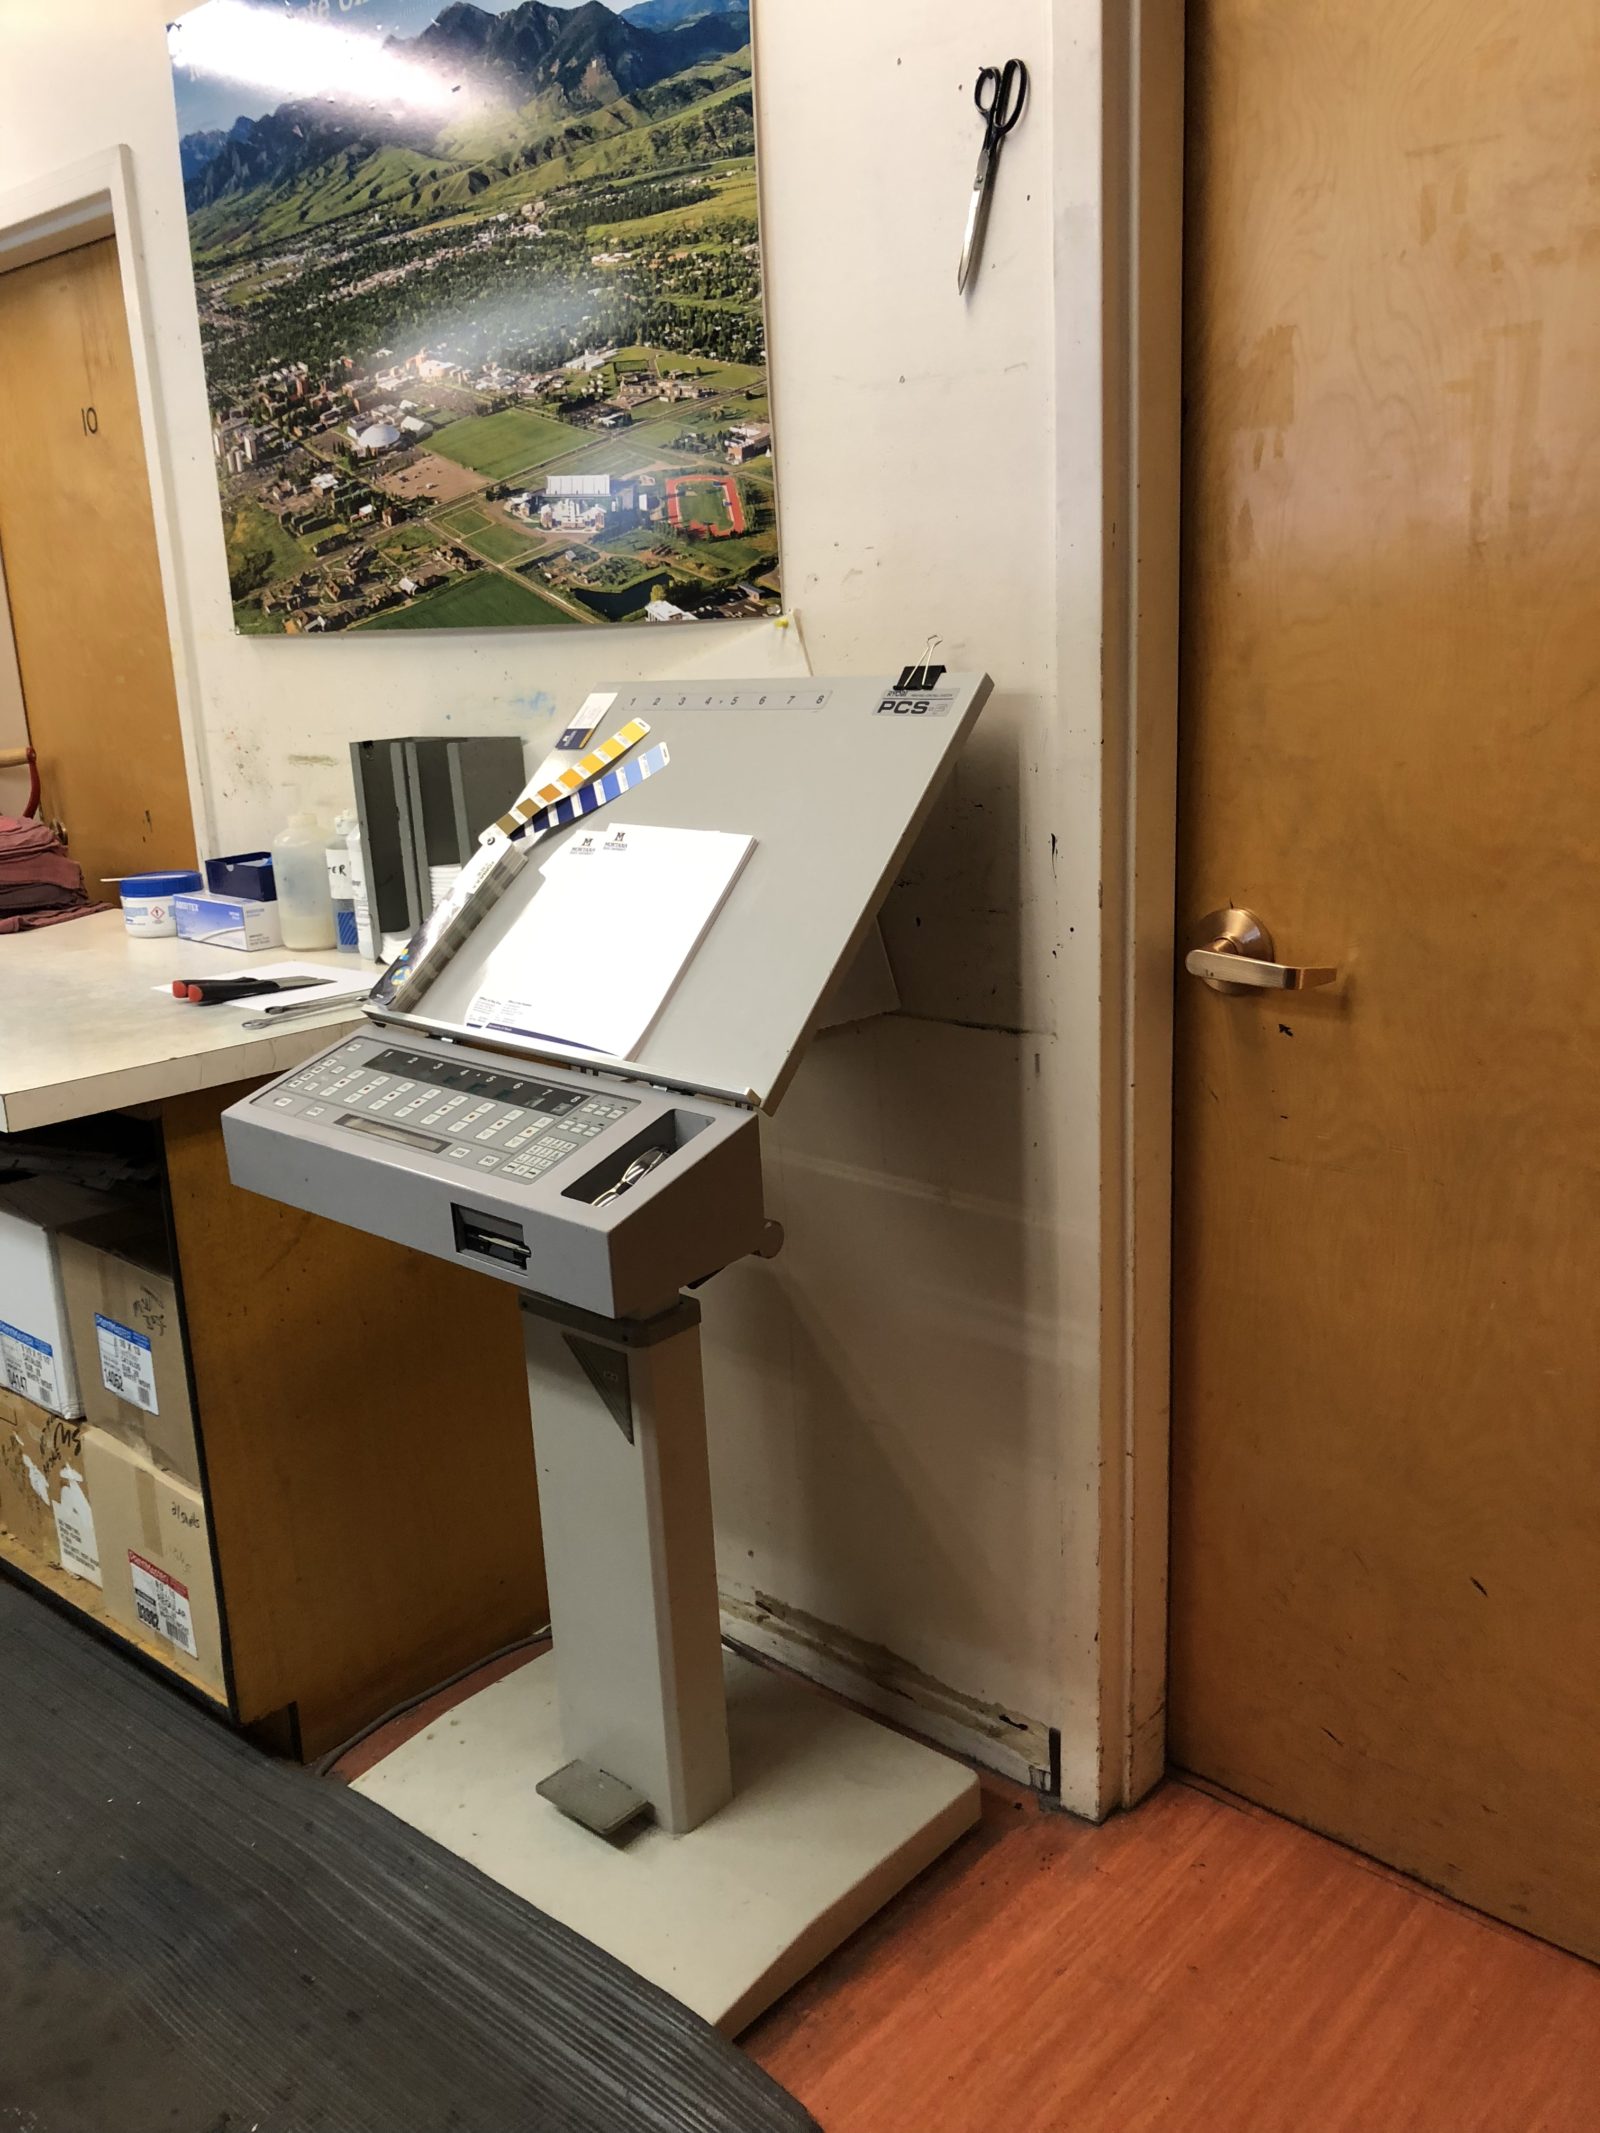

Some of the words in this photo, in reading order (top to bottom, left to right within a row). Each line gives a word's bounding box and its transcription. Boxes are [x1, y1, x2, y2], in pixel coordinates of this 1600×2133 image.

[81, 407, 98, 437] 10
[630, 697, 637, 706] 1
[652, 697, 661, 706] 2
[678, 697, 686, 706] 3
[705, 697, 713, 705] 4
[730, 696, 739, 705] 5
[759, 696, 767, 705] 6
[786, 695, 795, 704] 7
[815, 695, 825, 704] 8
[327, 864, 347, 877] ER
[407, 1056, 419, 1064] 2
[433, 1062, 444, 1070] 3
[459, 1069, 470, 1077] 4
[485, 1075, 497, 1083] 5
[512, 1082, 524, 1090] 6
[541, 1088, 553, 1096] 7
[570, 1095, 582, 1103] 8
